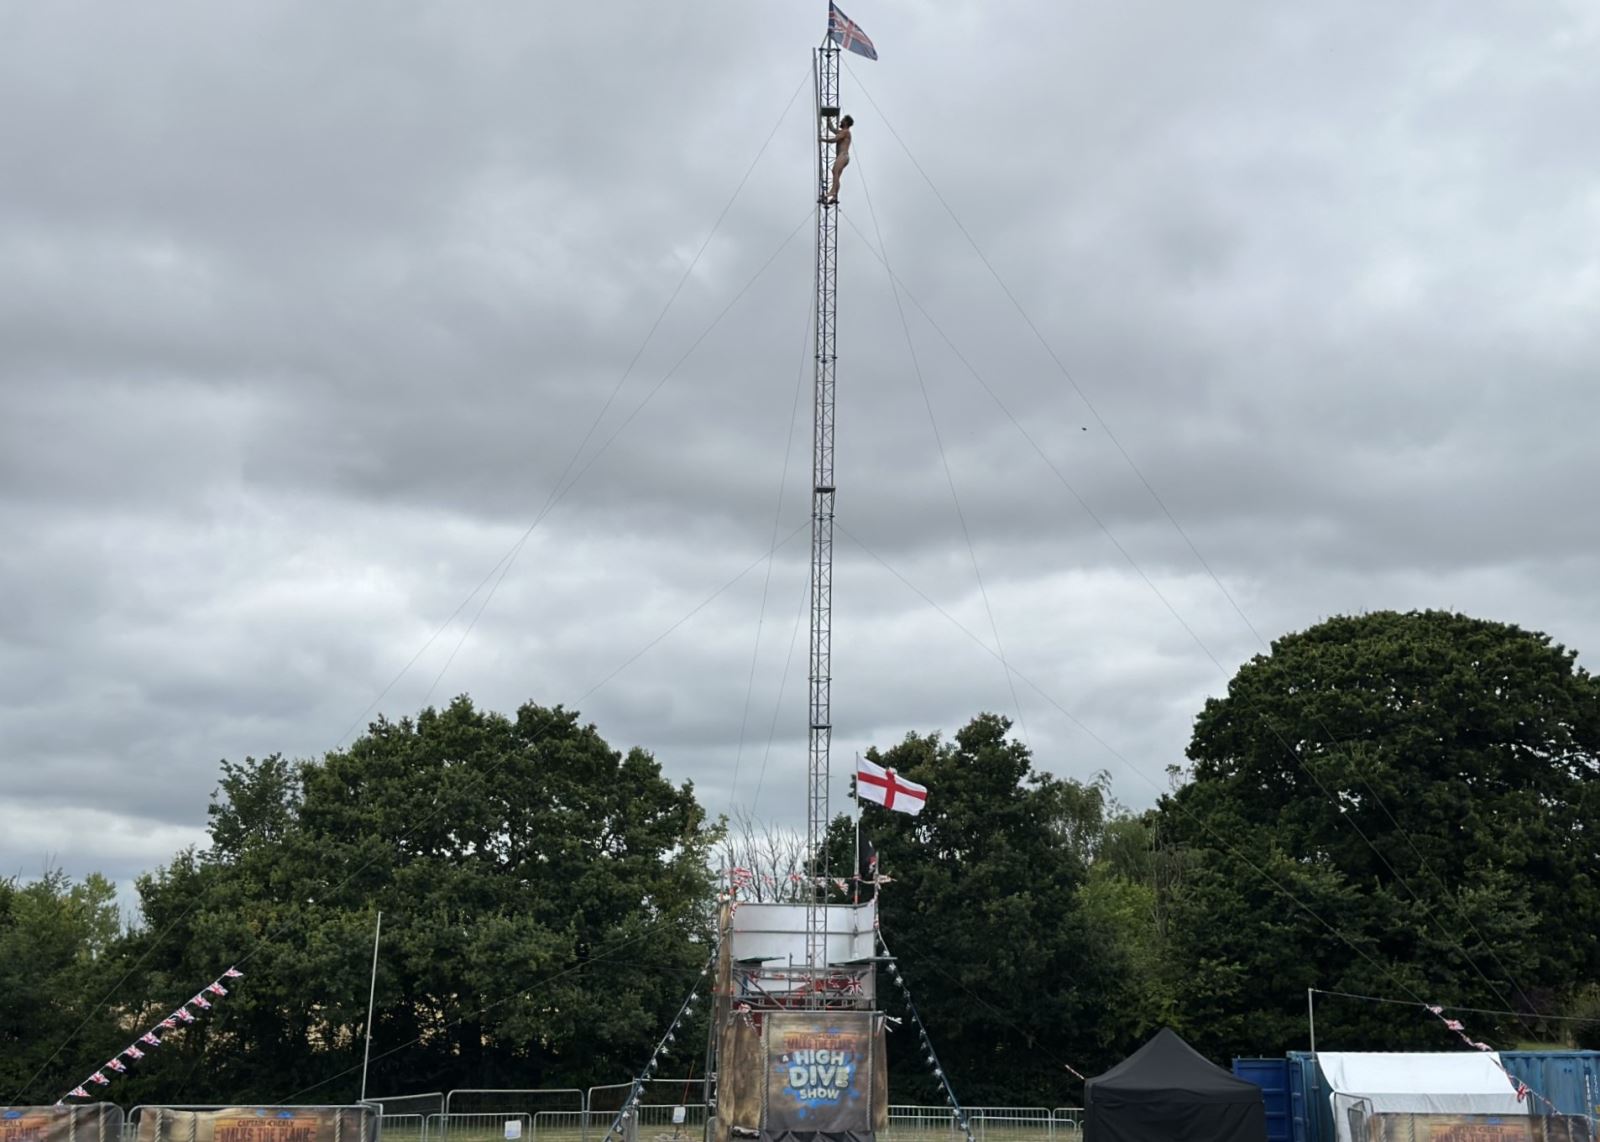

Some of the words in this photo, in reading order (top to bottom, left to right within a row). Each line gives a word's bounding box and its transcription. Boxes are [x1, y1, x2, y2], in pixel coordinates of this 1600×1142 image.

[795, 1049, 845, 1066] HIGH
[789, 1065, 850, 1088] DIVE
[800, 1088, 840, 1100] SHOW
[237, 1120, 266, 1128] CAPTAIN
[221, 1127, 255, 1142] WALKS
[257, 1127, 275, 1142] THE
[279, 1127, 311, 1142] PLANK
